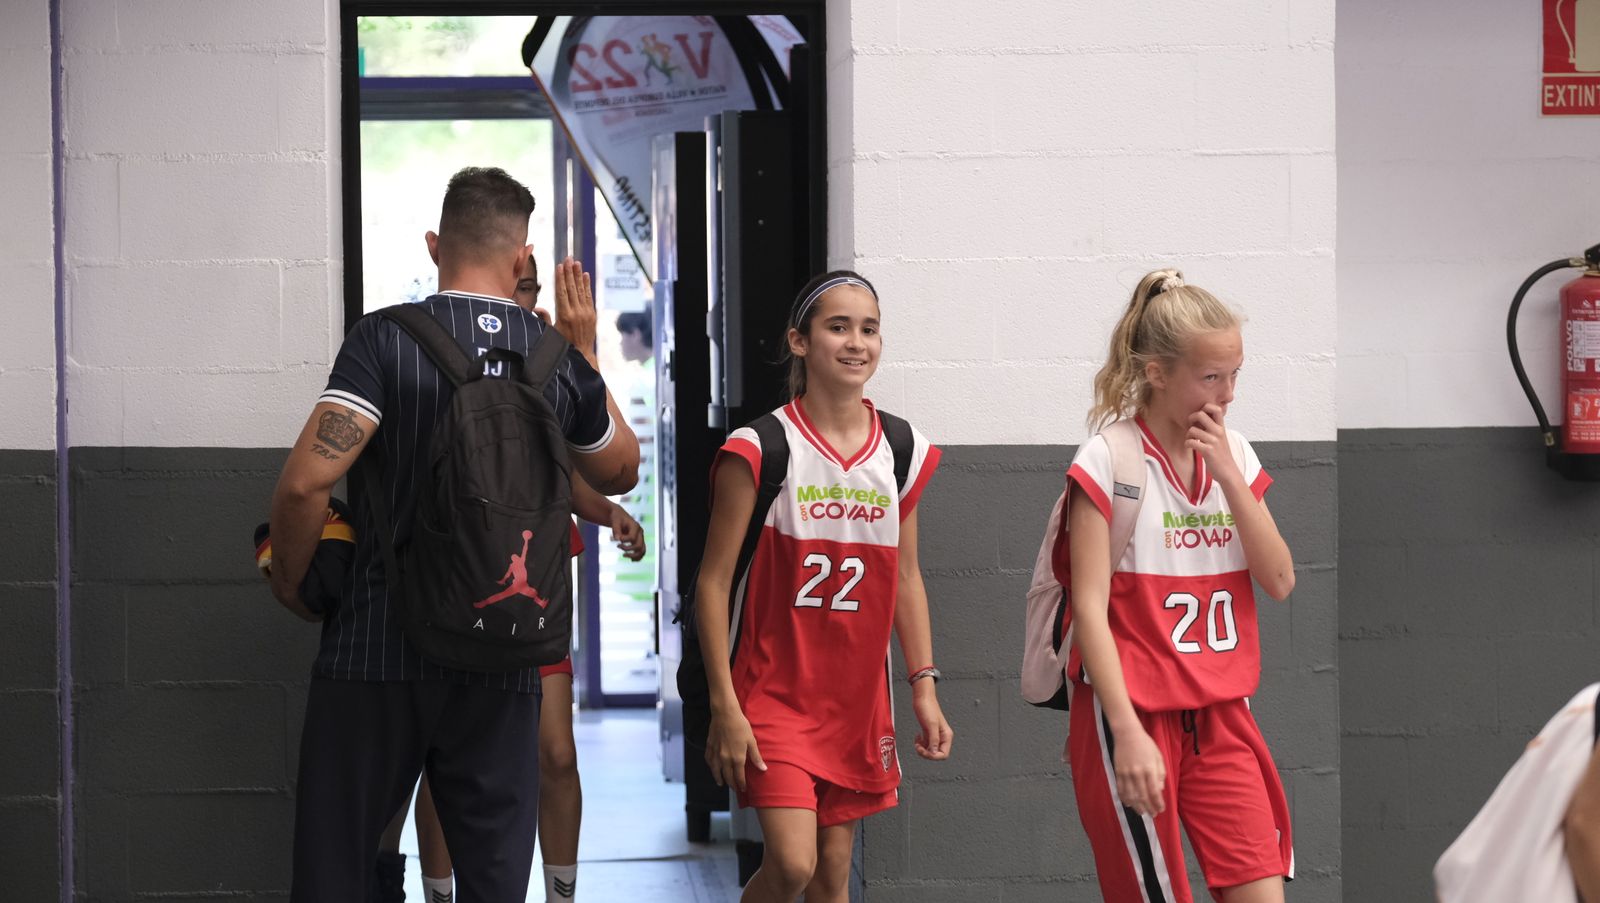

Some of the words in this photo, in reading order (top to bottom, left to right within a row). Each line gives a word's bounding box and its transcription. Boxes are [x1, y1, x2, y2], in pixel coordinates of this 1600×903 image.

[797, 483, 891, 508] Muévete
[799, 504, 808, 522] con
[809, 502, 885, 523] COVAP
[1173, 528, 1233, 549] COVAP
[793, 552, 865, 612] 22
[472, 616, 545, 635] AIR
[1163, 589, 1239, 653] 20
